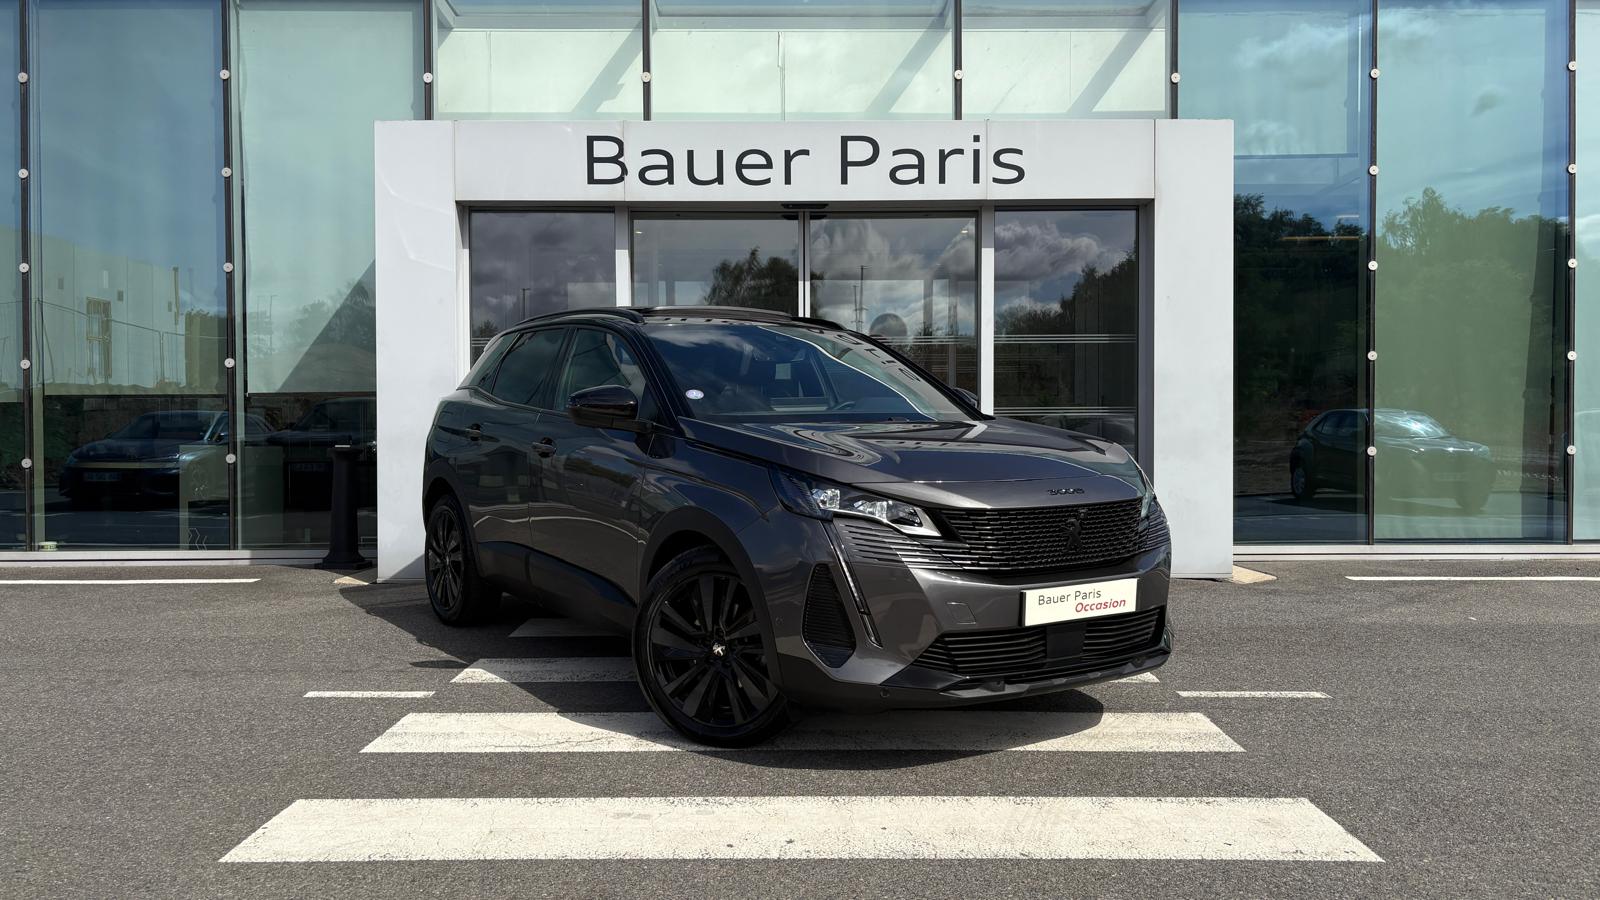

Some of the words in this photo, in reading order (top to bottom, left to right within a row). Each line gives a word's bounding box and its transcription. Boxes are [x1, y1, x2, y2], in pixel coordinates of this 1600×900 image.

[586, 135, 811, 187] Bauer
[841, 134, 1026, 187] Paris
[1038, 593, 1071, 606] Bauer
[1074, 588, 1102, 601] Paris
[1075, 598, 1126, 613] Occasion
